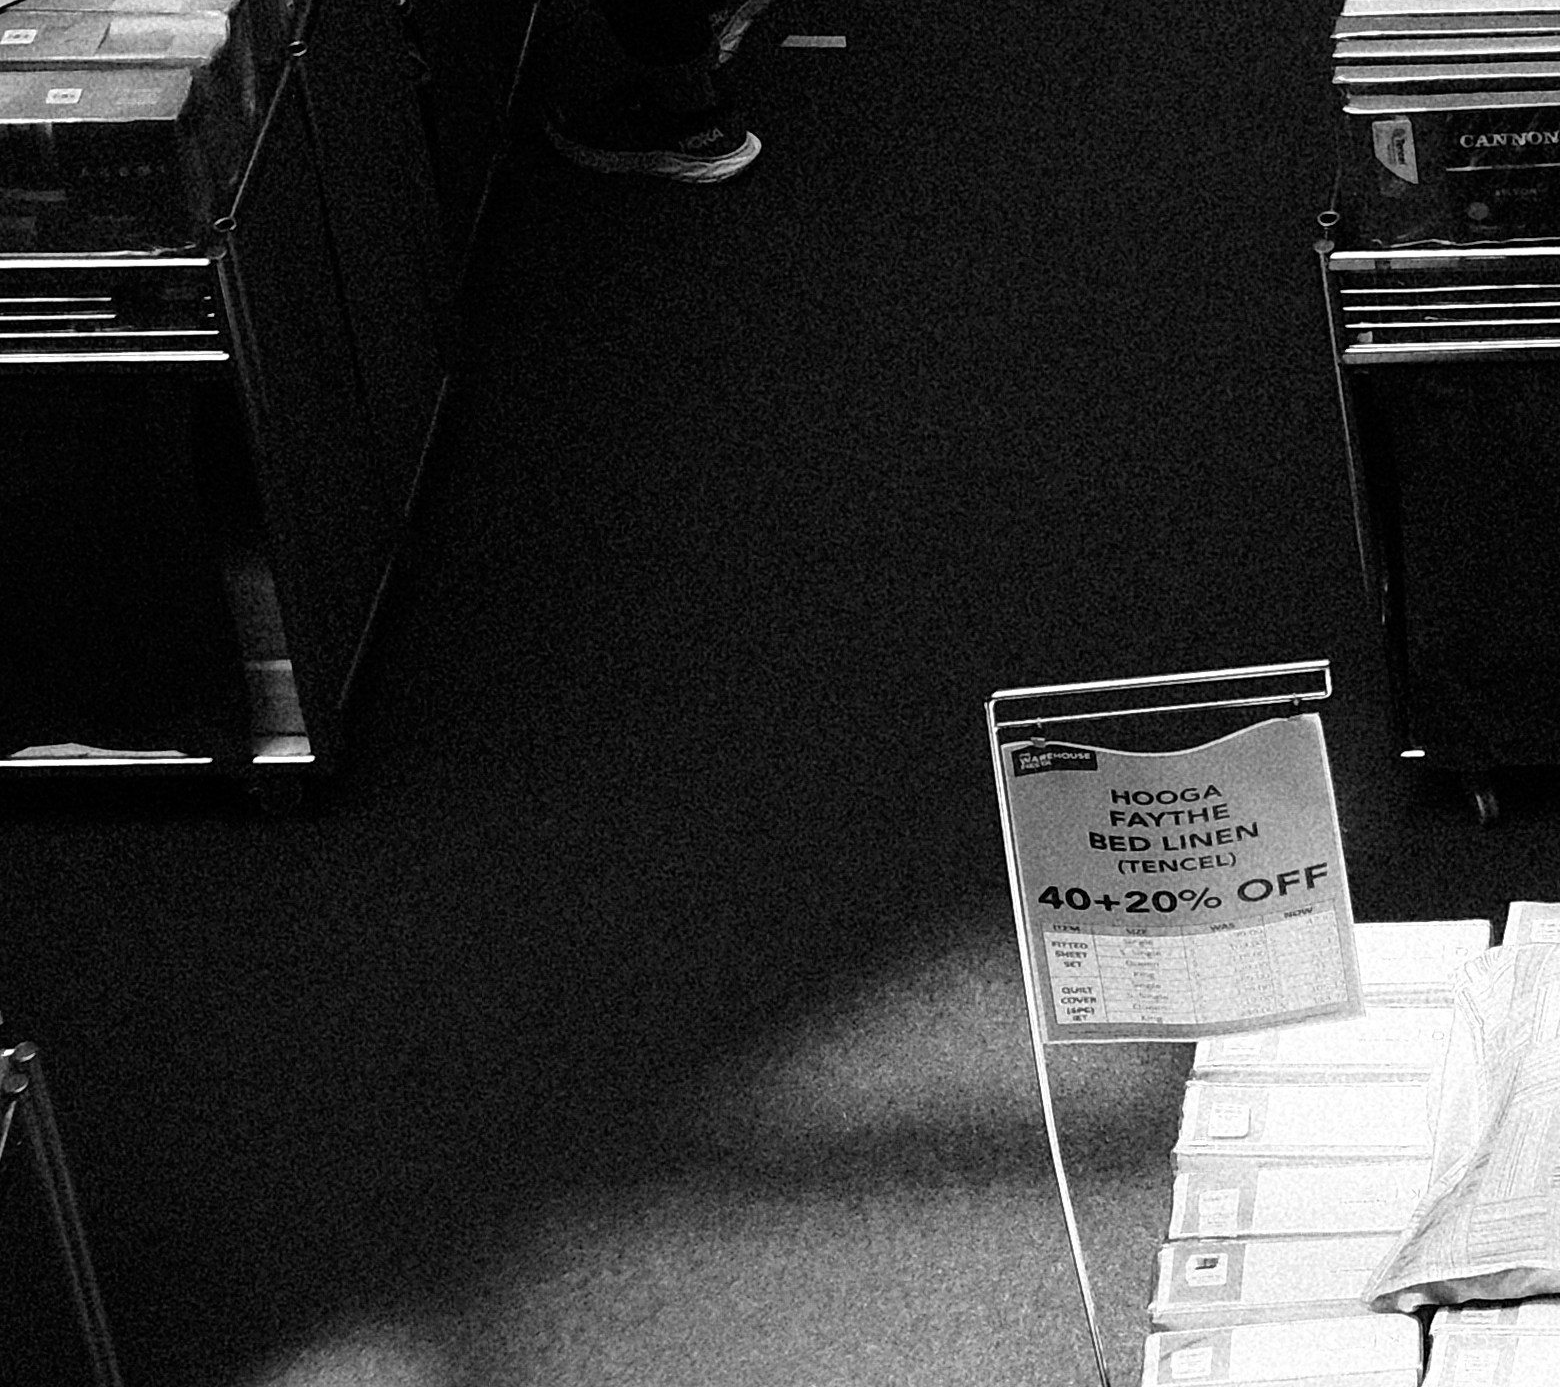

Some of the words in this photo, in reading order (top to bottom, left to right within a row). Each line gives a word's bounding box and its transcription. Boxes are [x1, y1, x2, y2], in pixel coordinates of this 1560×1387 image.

[1460, 131, 1560, 148] CANNON
[1021, 753, 1090, 768] WAREHOUSE
[1110, 784, 1223, 805] HOOGA
[1110, 803, 1230, 827] FAYTHE
[1089, 831, 1152, 852] BED
[1163, 822, 1259, 852] LINEN
[1118, 852, 1237, 875] (TENCEL)
[1038, 885, 1222, 913] 40+20%
[1237, 863, 1328, 904] OFF
[1210, 922, 1235, 932] WAS
[1052, 941, 1088, 949] FITTED
[1055, 950, 1088, 959] SHEET
[1061, 986, 1093, 994] QUILT
[1060, 997, 1097, 1005] COVER
